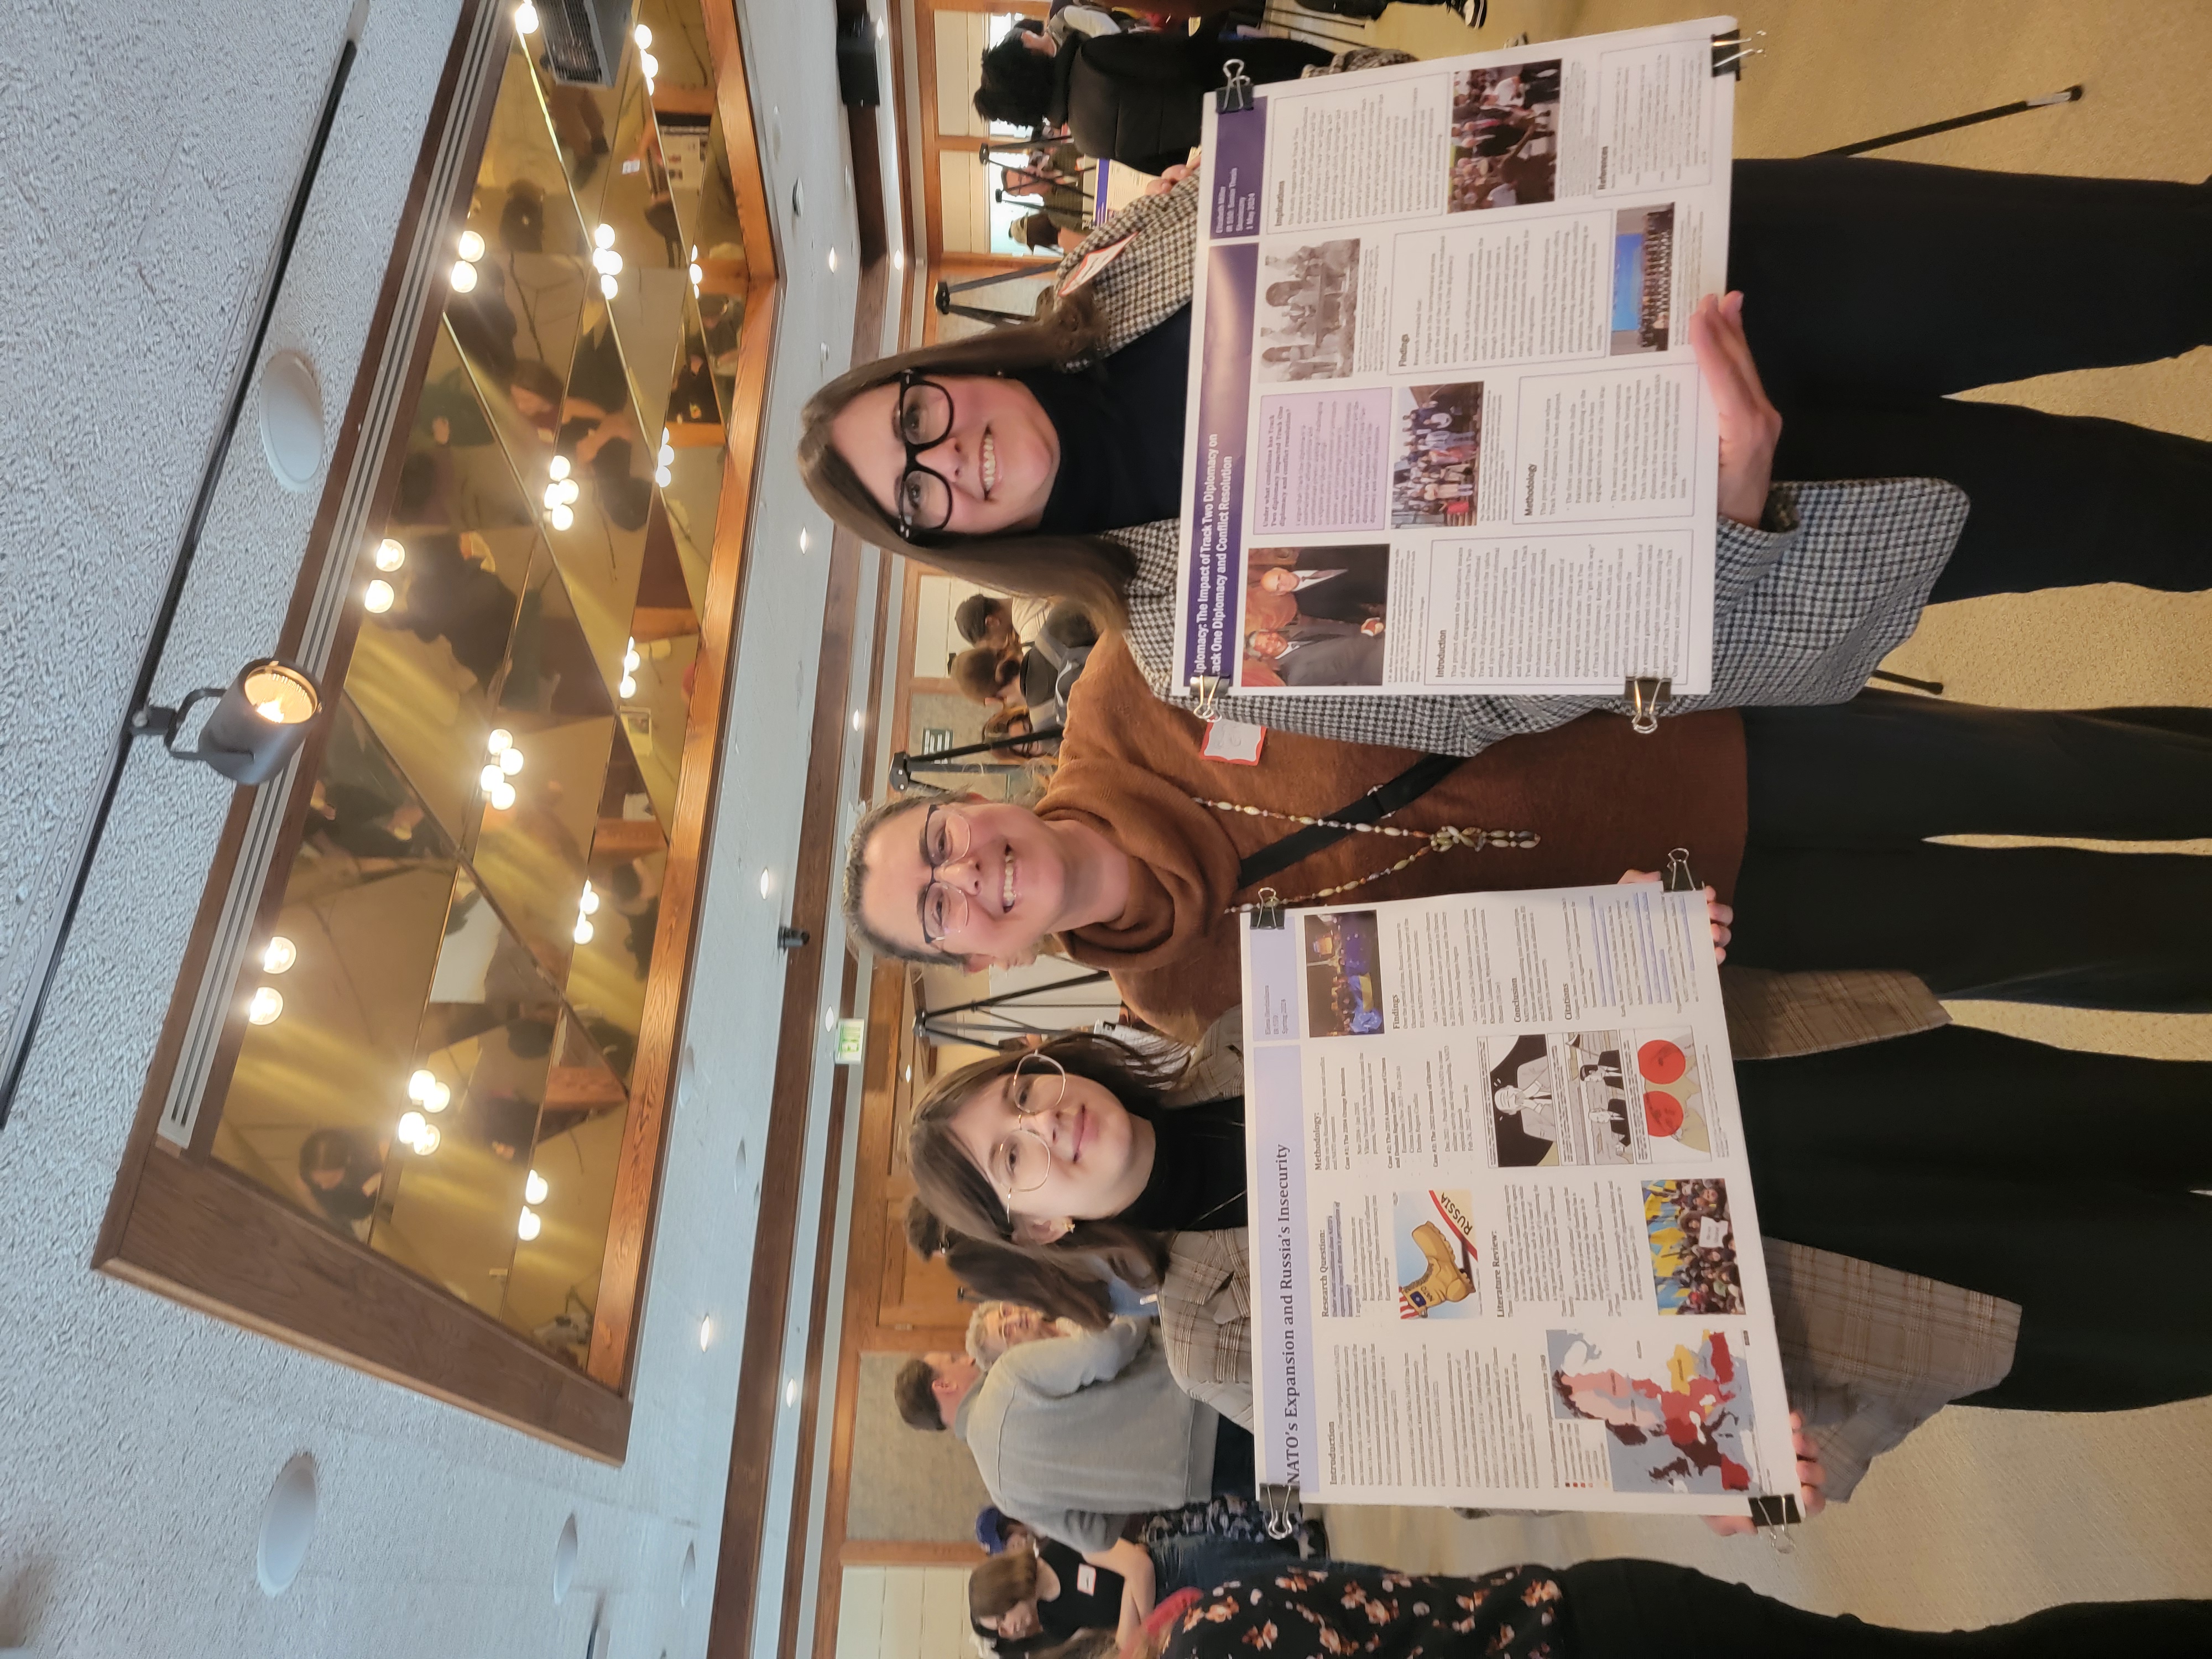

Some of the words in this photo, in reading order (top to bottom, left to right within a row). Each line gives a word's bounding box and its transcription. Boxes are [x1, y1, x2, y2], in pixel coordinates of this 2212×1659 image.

[1598, 146, 1608, 190] References
[1274, 180, 1286, 227] Implications
[1398, 334, 1410, 367] Findings
[1202, 448, 1219, 503] Diplomacy
[1218, 456, 1233, 510] Resolution
[1524, 464, 1537, 516] Methodology
[1202, 503, 1213, 524] Two
[1215, 512, 1229, 551] Conflict
[1200, 525, 1212, 552] Track
[1198, 566, 1211, 602] Impact
[1215, 553, 1227, 573] and
[1196, 604, 1208, 622] The
[1212, 575, 1227, 629] Diplomacy
[1194, 624, 1208, 673] iplomacy:
[1211, 631, 1223, 652] One
[1435, 630, 1446, 677] Introduction
[1390, 995, 1401, 1029] Findings
[1510, 978, 1521, 1023] Conclusion
[1561, 983, 1572, 1020] Citations
[1312, 1113, 1323, 1170] Methodology:
[1275, 1144, 1292, 1222] Insecurity
[1440, 1192, 1473, 1235] RUSSIA
[1278, 1227, 1292, 1289] Russia’s
[1318, 1230, 1328, 1273] Question:
[1489, 1232, 1500, 1267] Review:
[1280, 1295, 1293, 1324] and
[1320, 1276, 1329, 1317] Research
[1421, 1286, 1433, 1302] NATO
[1493, 1270, 1505, 1317] Literature
[1282, 1330, 1301, 1418] Expansion
[1285, 1423, 1300, 1485] NATO’s
[1327, 1421, 1337, 1485] Introduction
